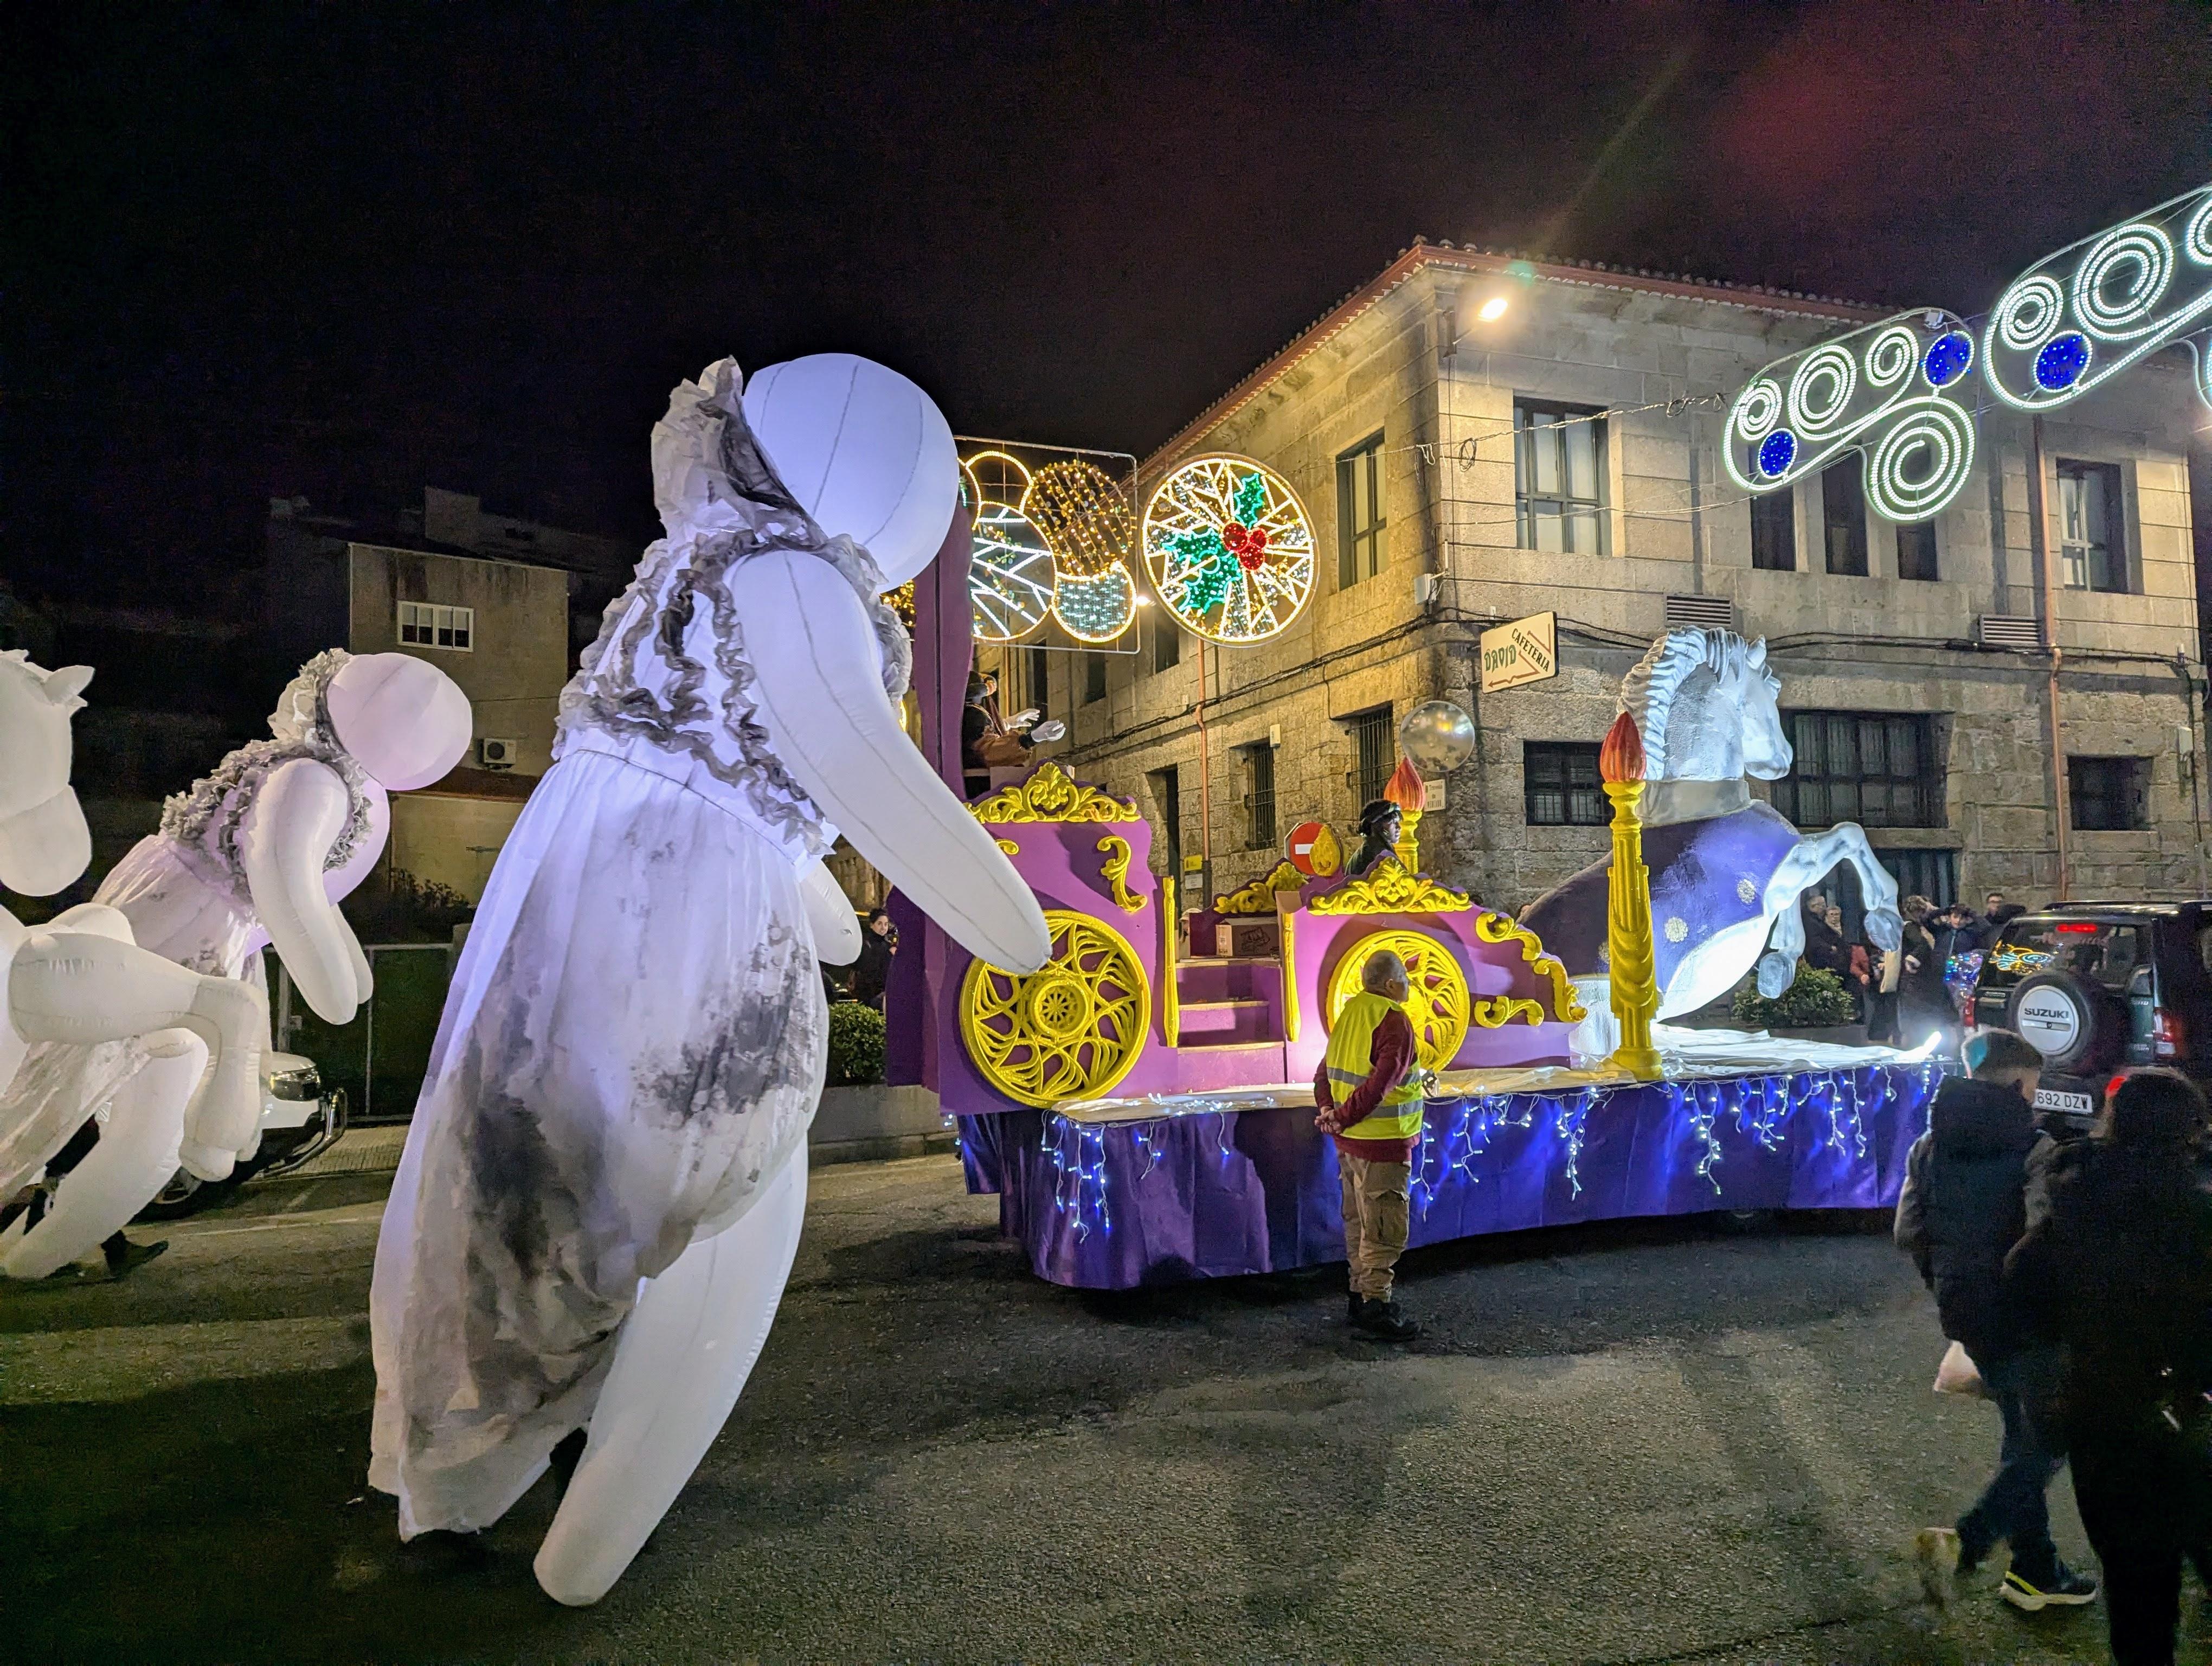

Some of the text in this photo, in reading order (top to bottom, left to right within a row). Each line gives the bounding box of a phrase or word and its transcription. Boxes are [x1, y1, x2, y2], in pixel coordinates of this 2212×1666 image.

[1484, 644, 1516, 672] DAVID
[1512, 628, 1550, 672] CAFETERIA
[2024, 1008, 2069, 1018] SUZUKI
[2037, 1092, 2060, 1106] 692
